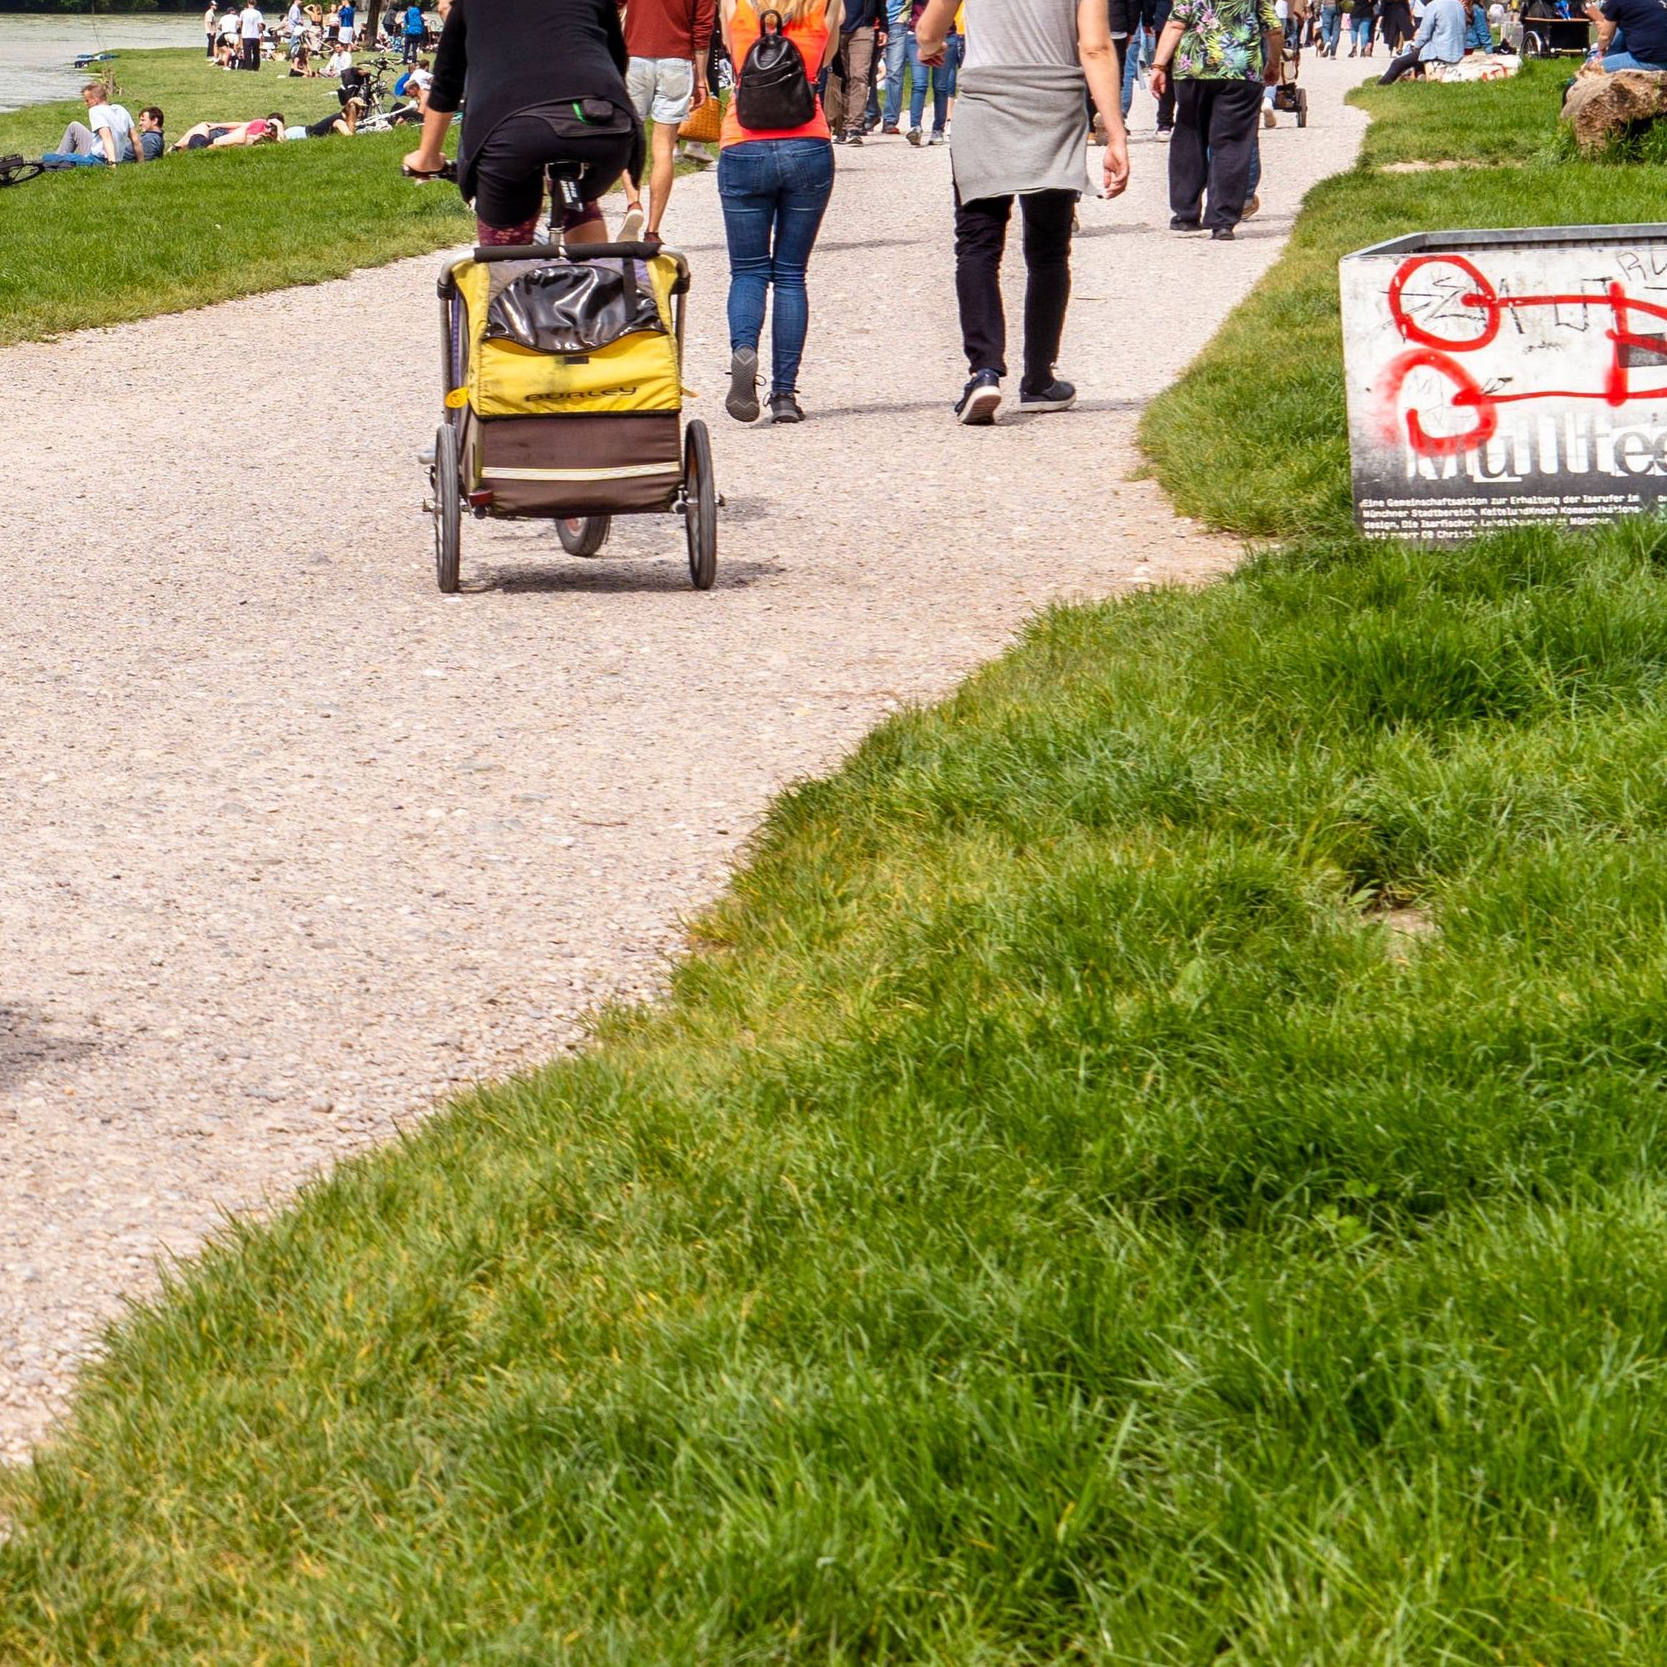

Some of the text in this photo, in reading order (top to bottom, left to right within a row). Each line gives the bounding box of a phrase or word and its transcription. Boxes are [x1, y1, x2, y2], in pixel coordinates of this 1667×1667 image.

[524, 386, 637, 403] BURLEY
[1362, 498, 1385, 508] Eine
[1387, 497, 1488, 507] Gemeinschaftsaktion
[1491, 497, 1509, 505] zur
[1510, 495, 1560, 505] Erhaltung
[1563, 495, 1581, 504] der
[1582, 494, 1626, 503] Isarufer
[1362, 509, 1409, 518] Münchner
[1401, 519, 1419, 529] Die
